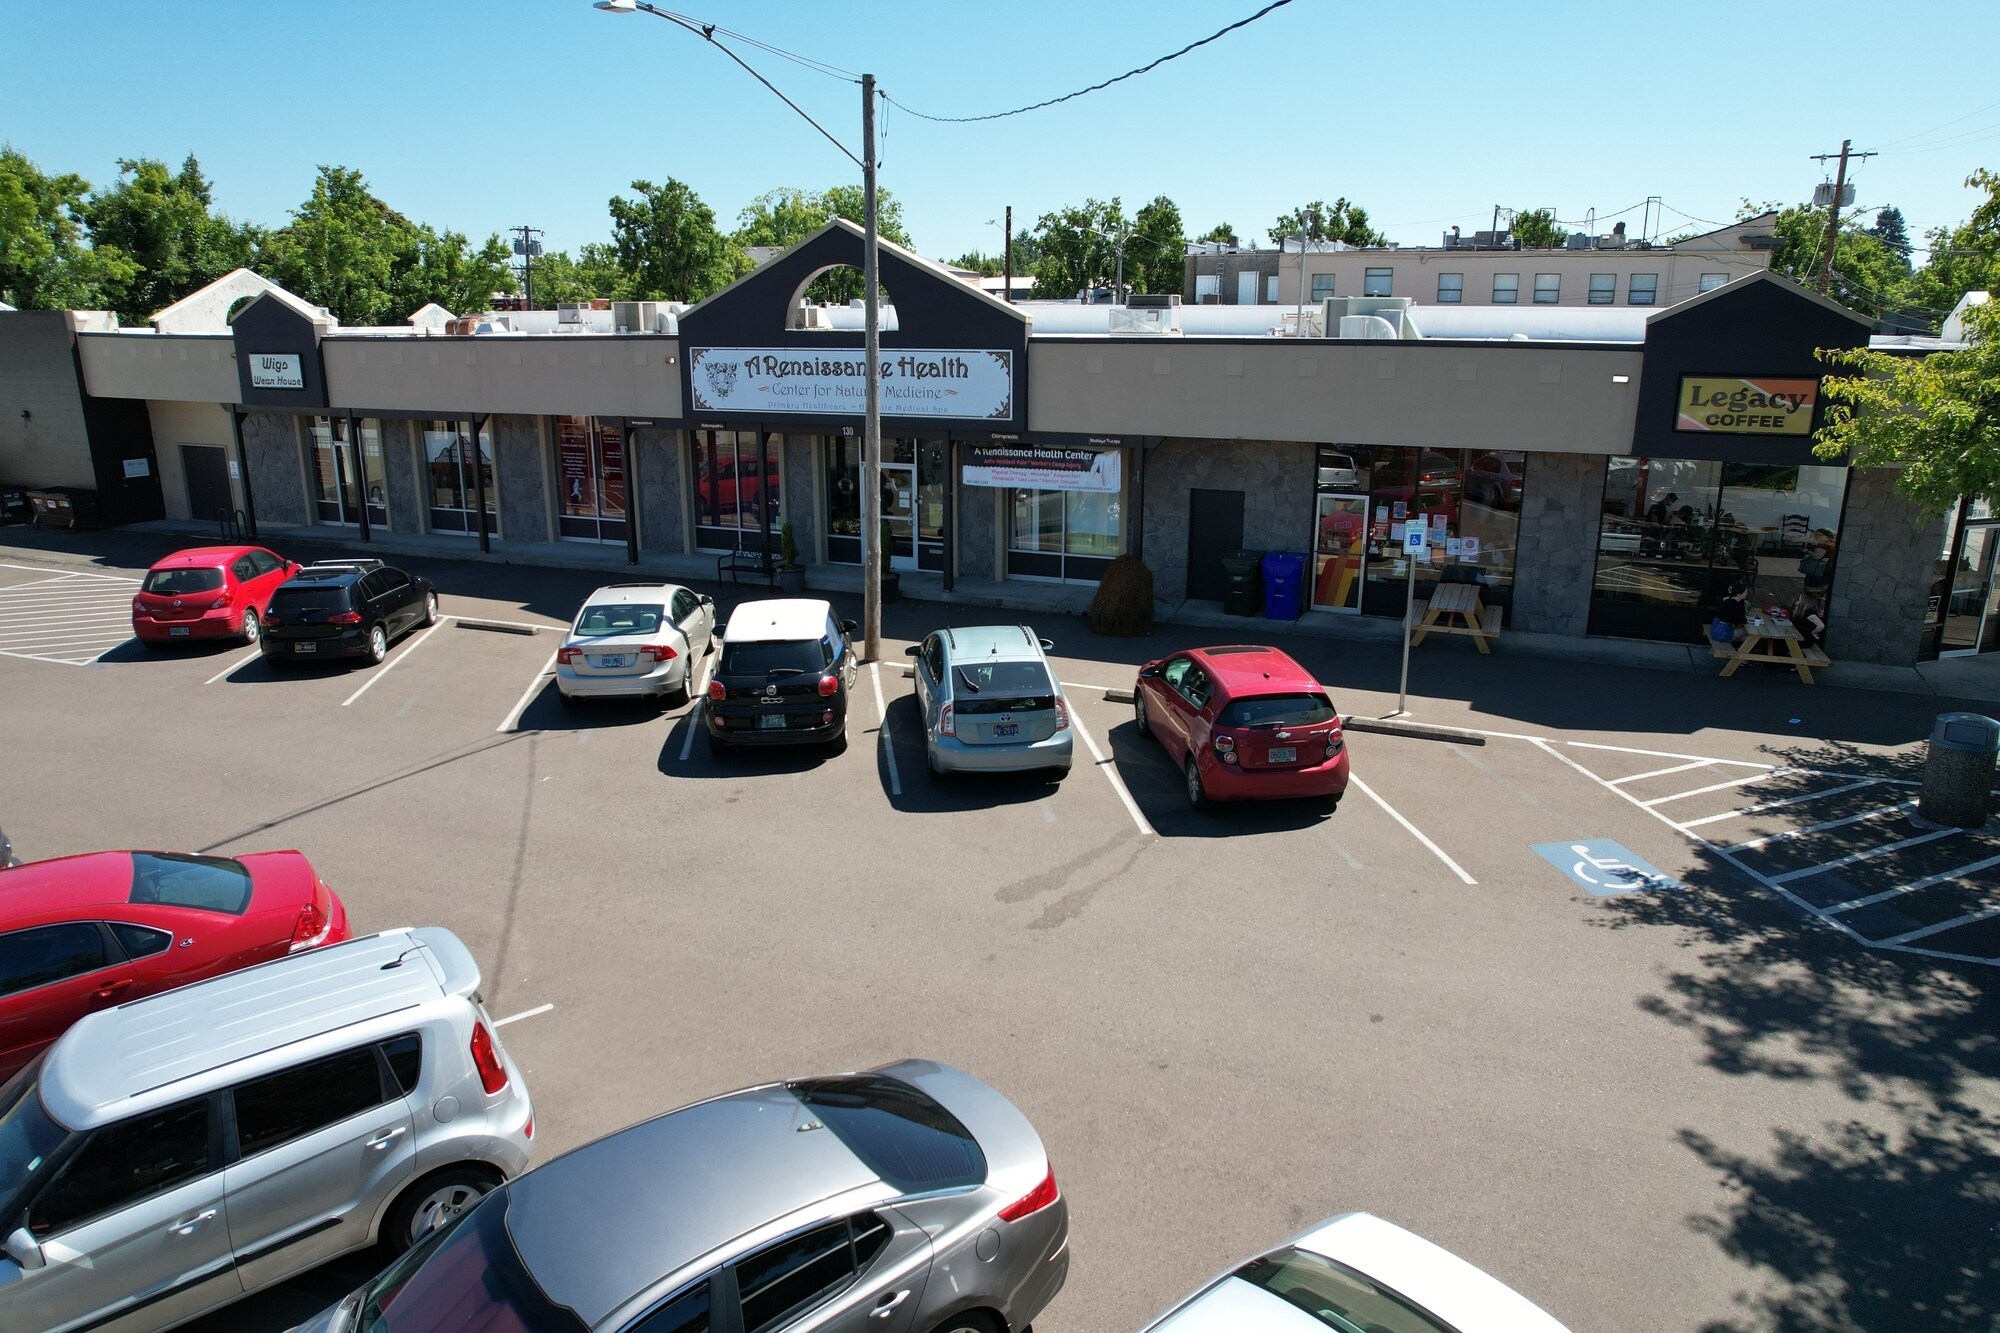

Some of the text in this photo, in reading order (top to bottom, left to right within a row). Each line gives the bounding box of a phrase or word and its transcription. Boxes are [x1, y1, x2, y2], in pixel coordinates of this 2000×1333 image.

[262, 357, 288, 373] Wigs
[744, 355, 968, 380] A Renaissane Health
[254, 376, 301, 385] Wear House
[772, 382, 942, 400] Center for Natur Medicine
[1689, 385, 1808, 414] Legacy
[768, 401, 800, 409] Primary
[802, 402, 847, 410] Healthcare
[895, 404, 929, 412] Medical
[933, 405, 949, 413] Spa
[1705, 414, 1785, 428] COFFEE
[842, 426, 854, 437] 130
[974, 446, 1093, 460] A Renaissance Health Center
